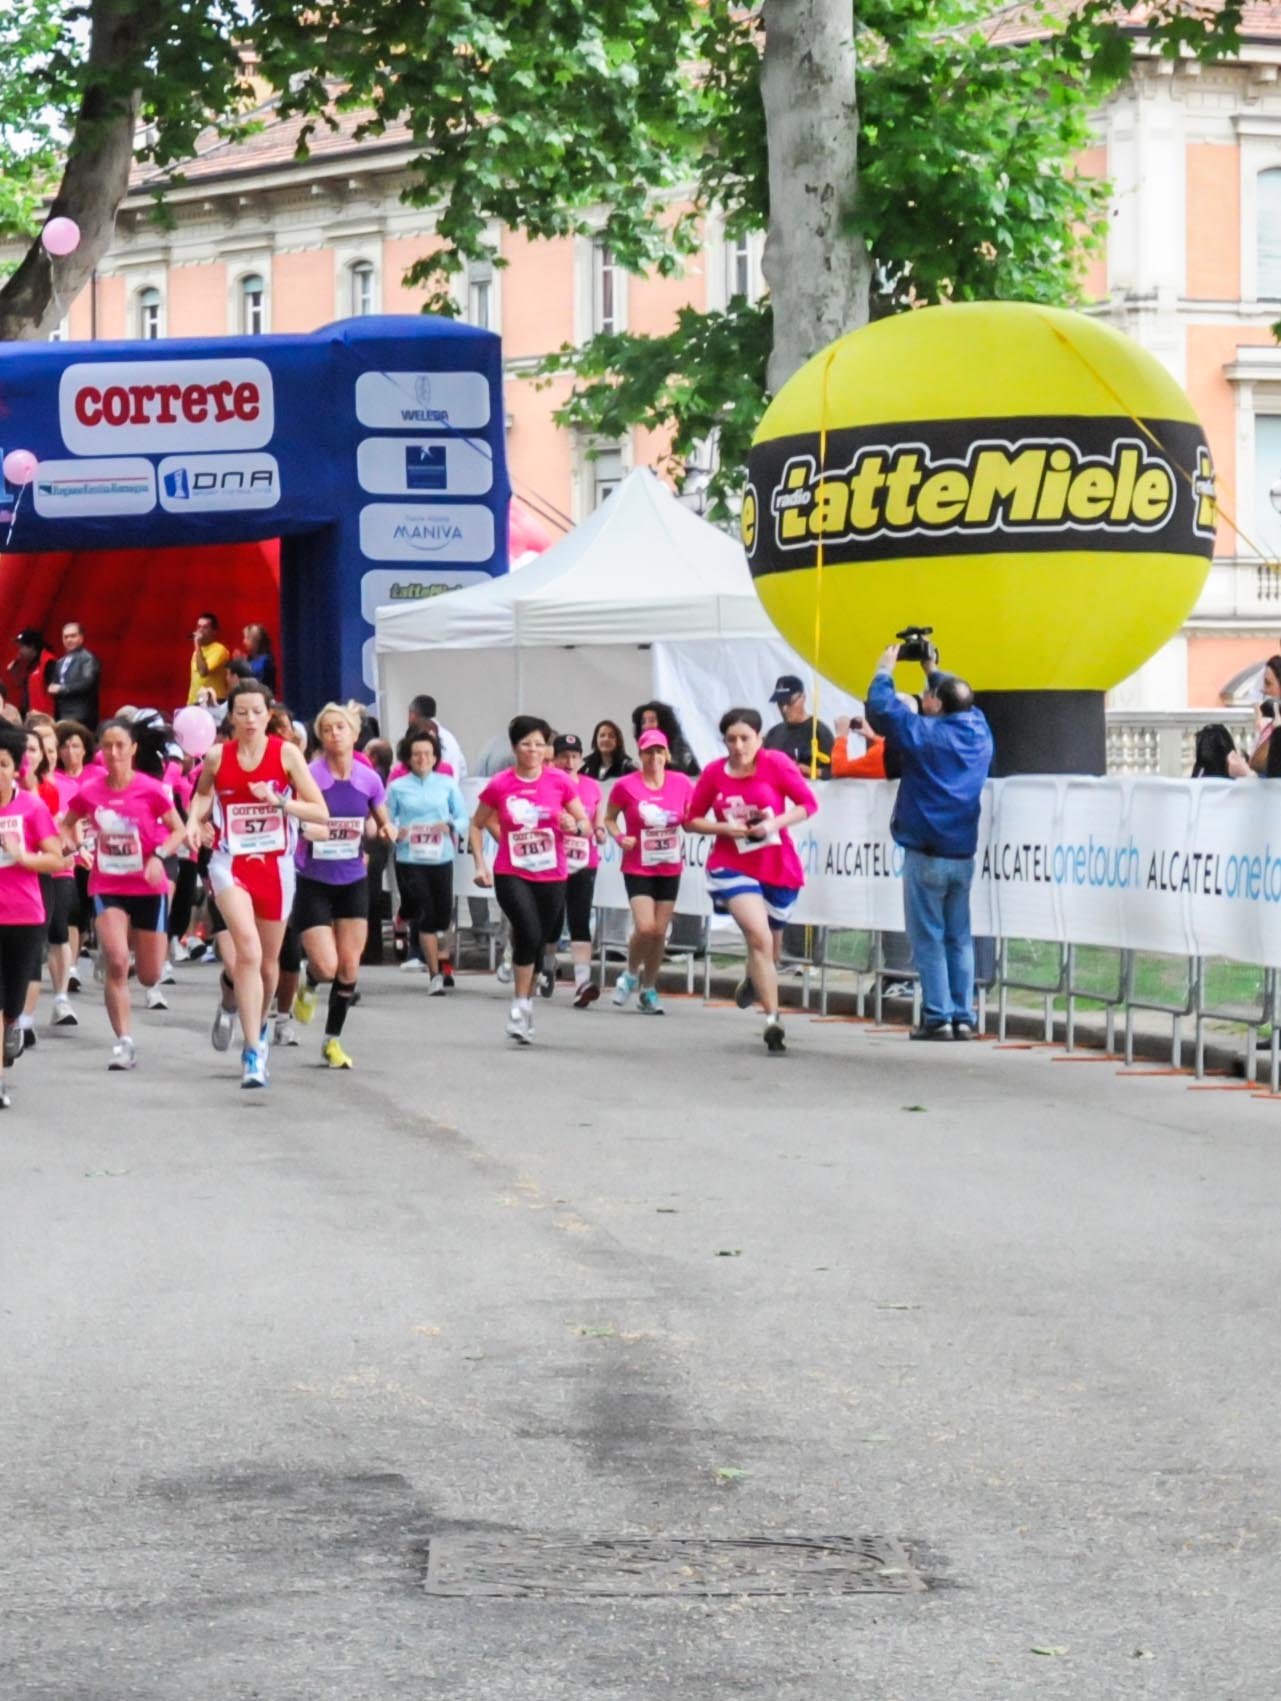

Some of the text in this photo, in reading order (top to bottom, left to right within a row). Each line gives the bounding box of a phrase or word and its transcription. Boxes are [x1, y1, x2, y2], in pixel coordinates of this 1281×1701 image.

[781, 447, 1171, 539] LatteMiele
[393, 525, 463, 540] MANIVA
[245, 819, 267, 834] 57
[520, 840, 547, 856] 181
[824, 842, 890, 878] ALCATEL
[981, 843, 1052, 882] ALCATEL
[1147, 850, 1222, 895] ALCATEL
